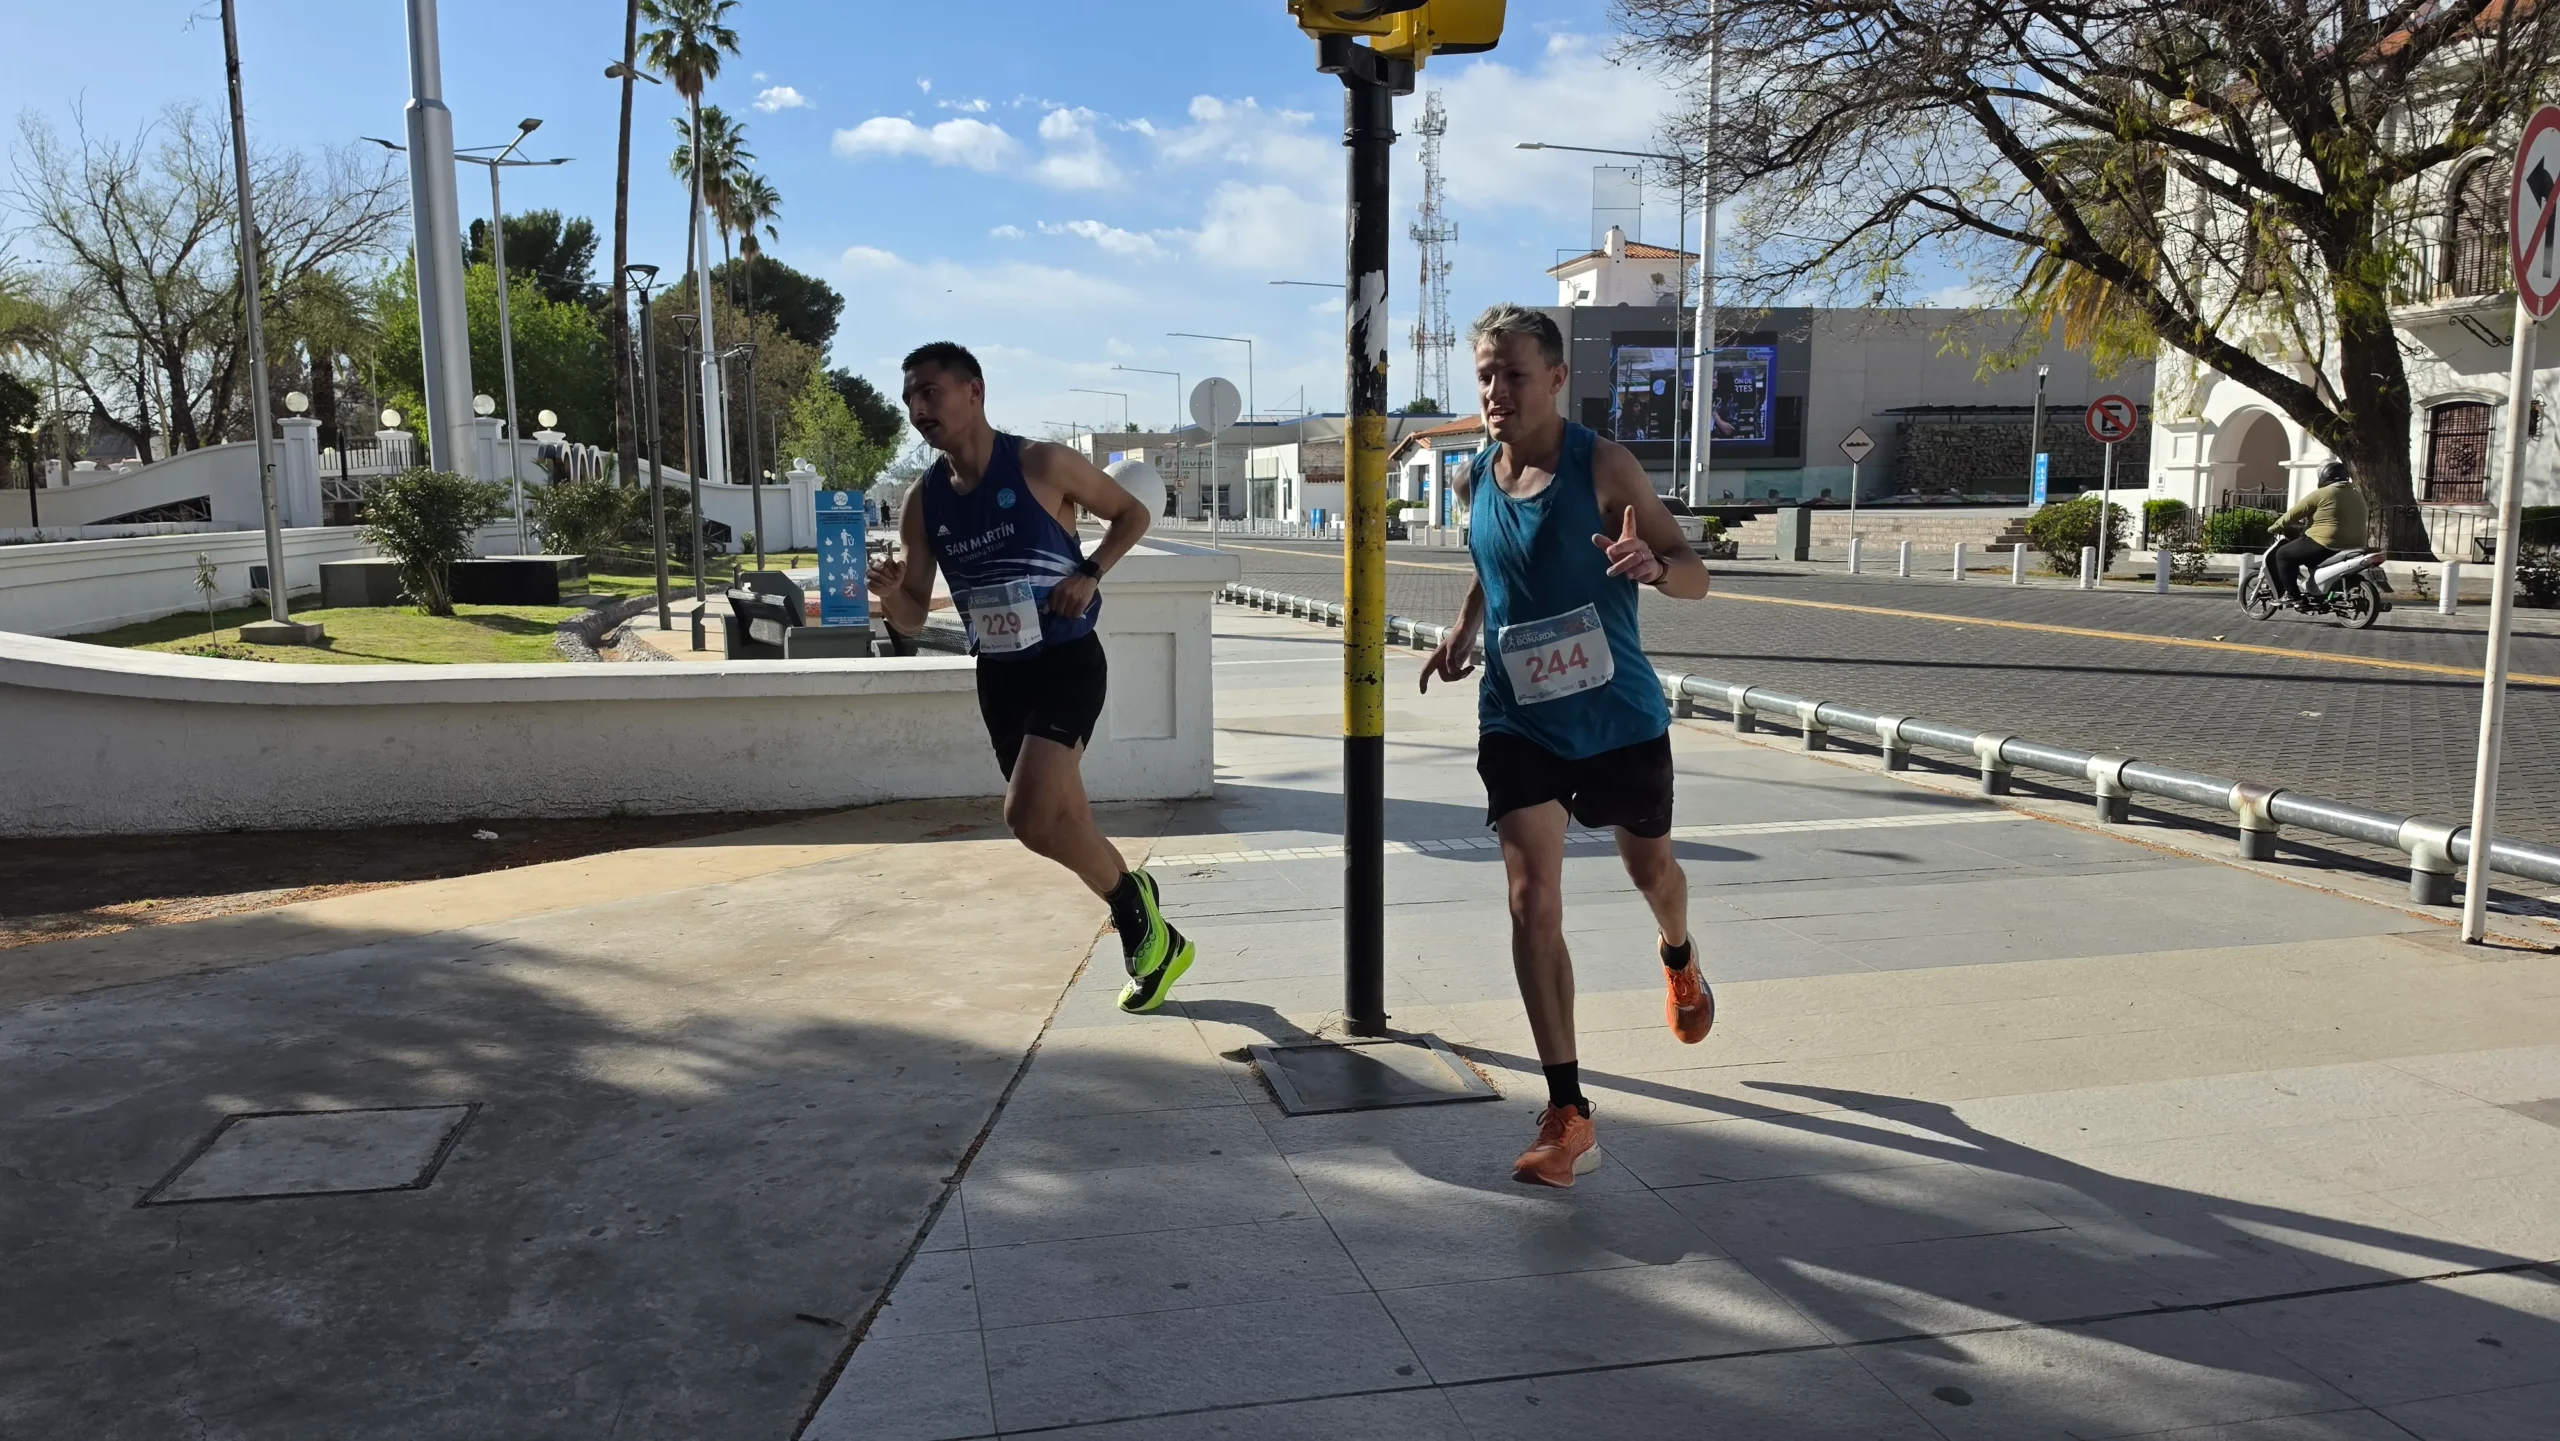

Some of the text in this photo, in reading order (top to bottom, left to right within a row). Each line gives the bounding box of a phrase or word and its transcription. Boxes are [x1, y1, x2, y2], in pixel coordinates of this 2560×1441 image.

[945, 522, 1015, 555] SAN MARTÍN
[958, 541, 1005, 563] RUNNING TEAM
[982, 611, 1022, 636] 229
[1516, 630, 1556, 646] BONARDA
[1526, 642, 1589, 684] 244
